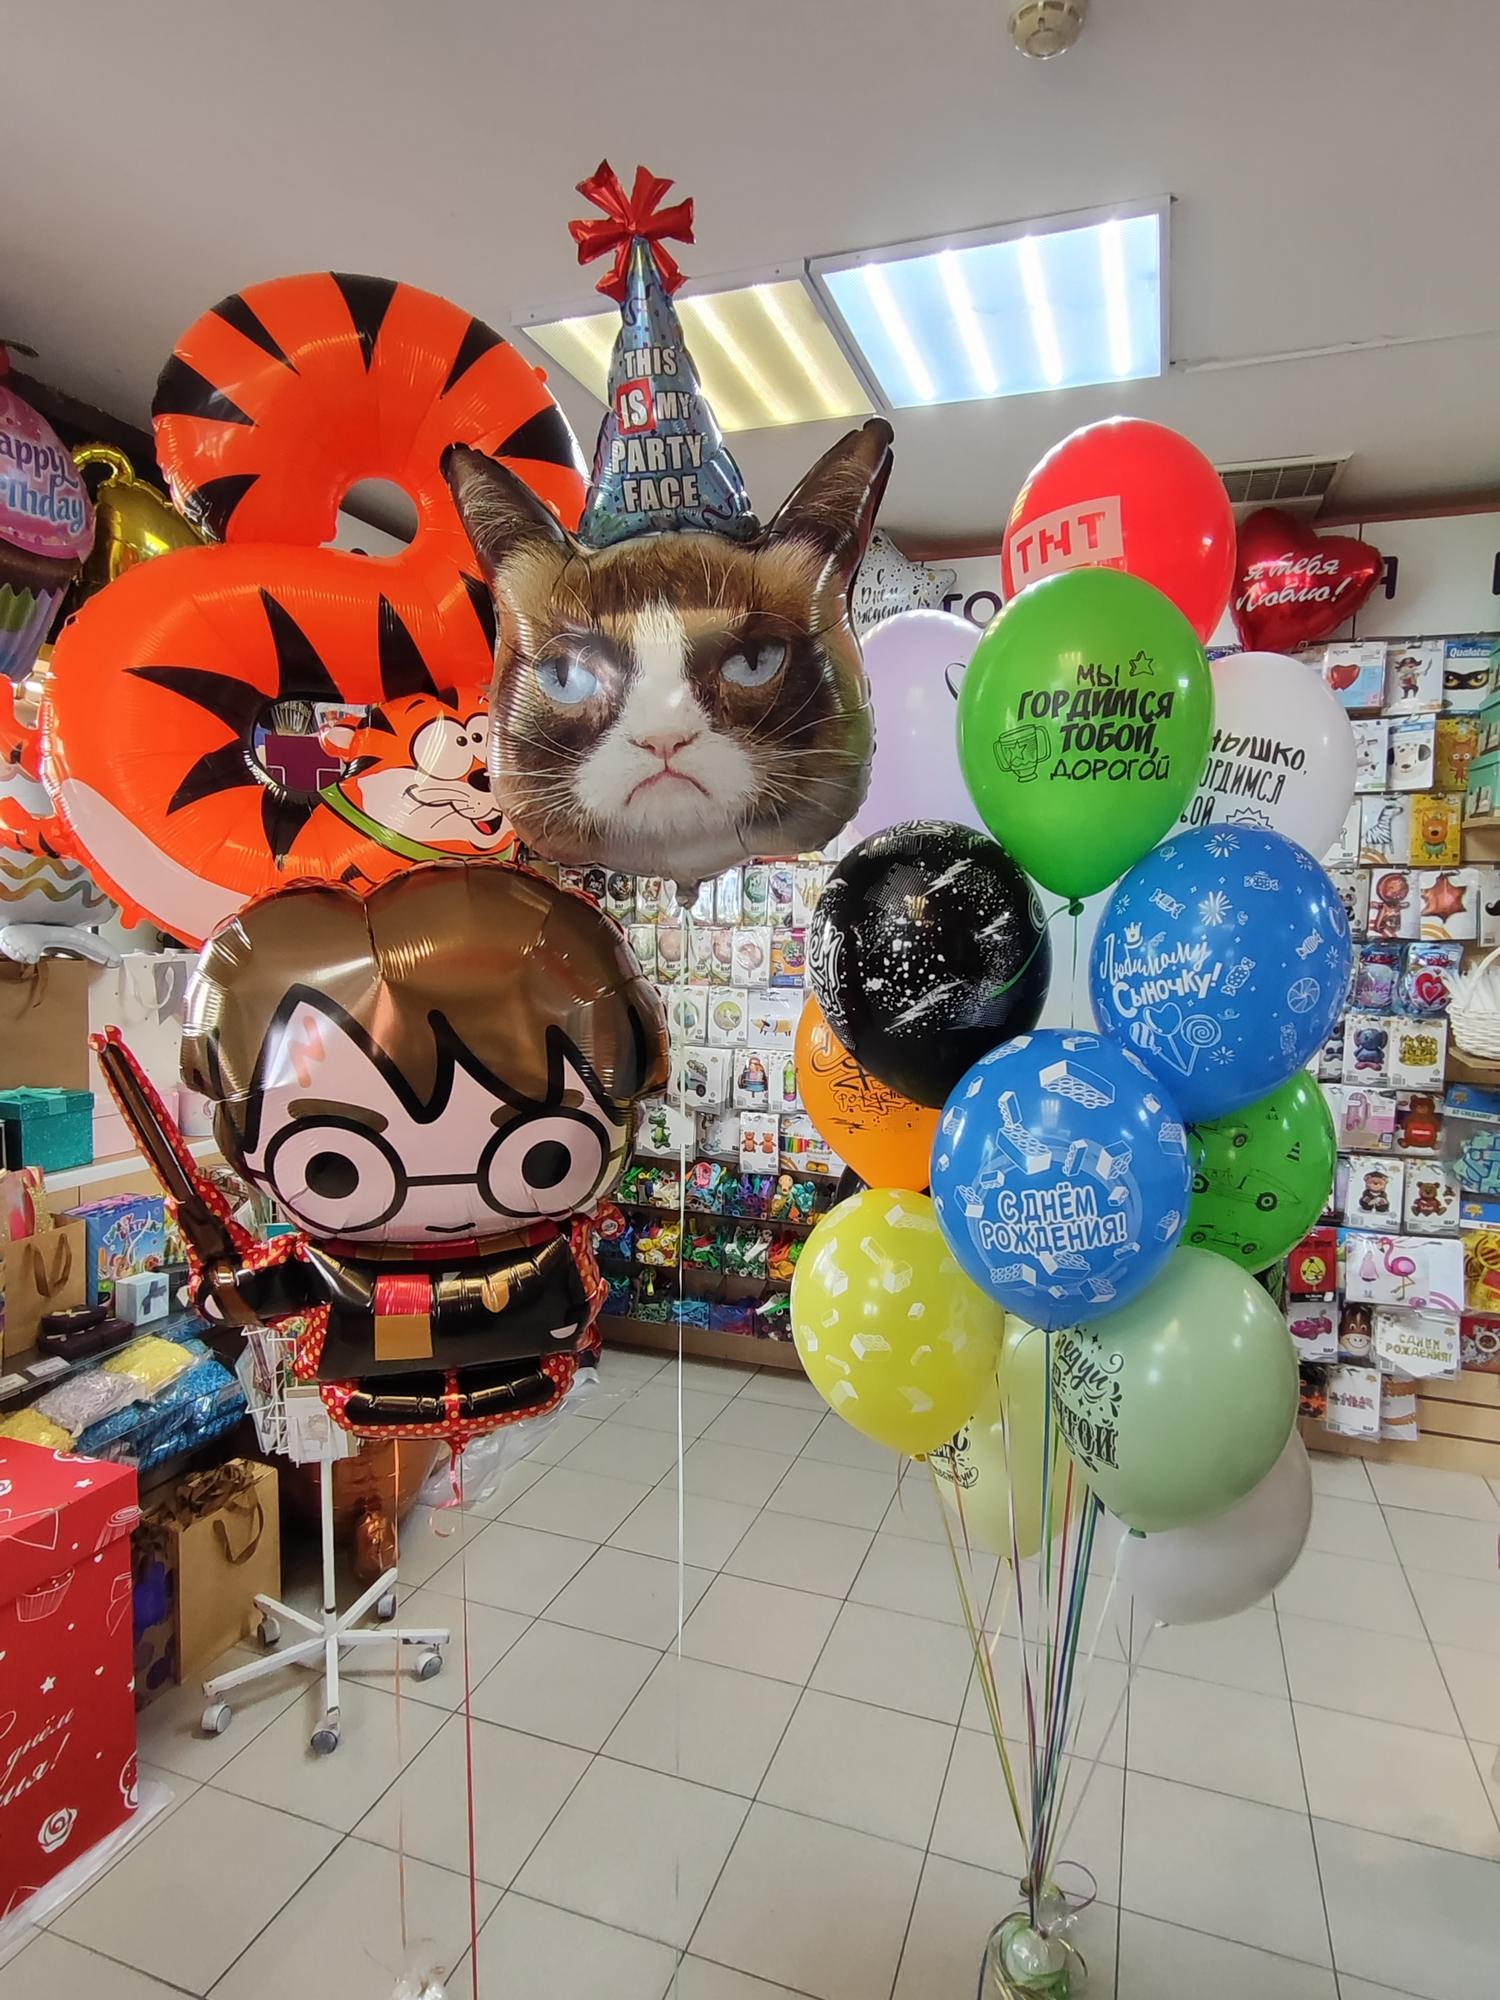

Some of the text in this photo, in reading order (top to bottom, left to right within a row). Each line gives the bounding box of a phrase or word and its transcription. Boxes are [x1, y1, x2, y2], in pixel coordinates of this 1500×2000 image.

[624, 348, 677, 379] THIS
[619, 389, 691, 430] IS MY
[0, 432, 79, 489] appy
[611, 434, 703, 474] PARTY
[622, 474, 700, 513] FACE
[1076, 663, 1120, 687] МЫ
[1017, 687, 1175, 724] ГОРДИМСЯ
[998, 1181, 1098, 1228] С ДНЁМ
[979, 1211, 1128, 1259] РОЖДЕНИЯ!
